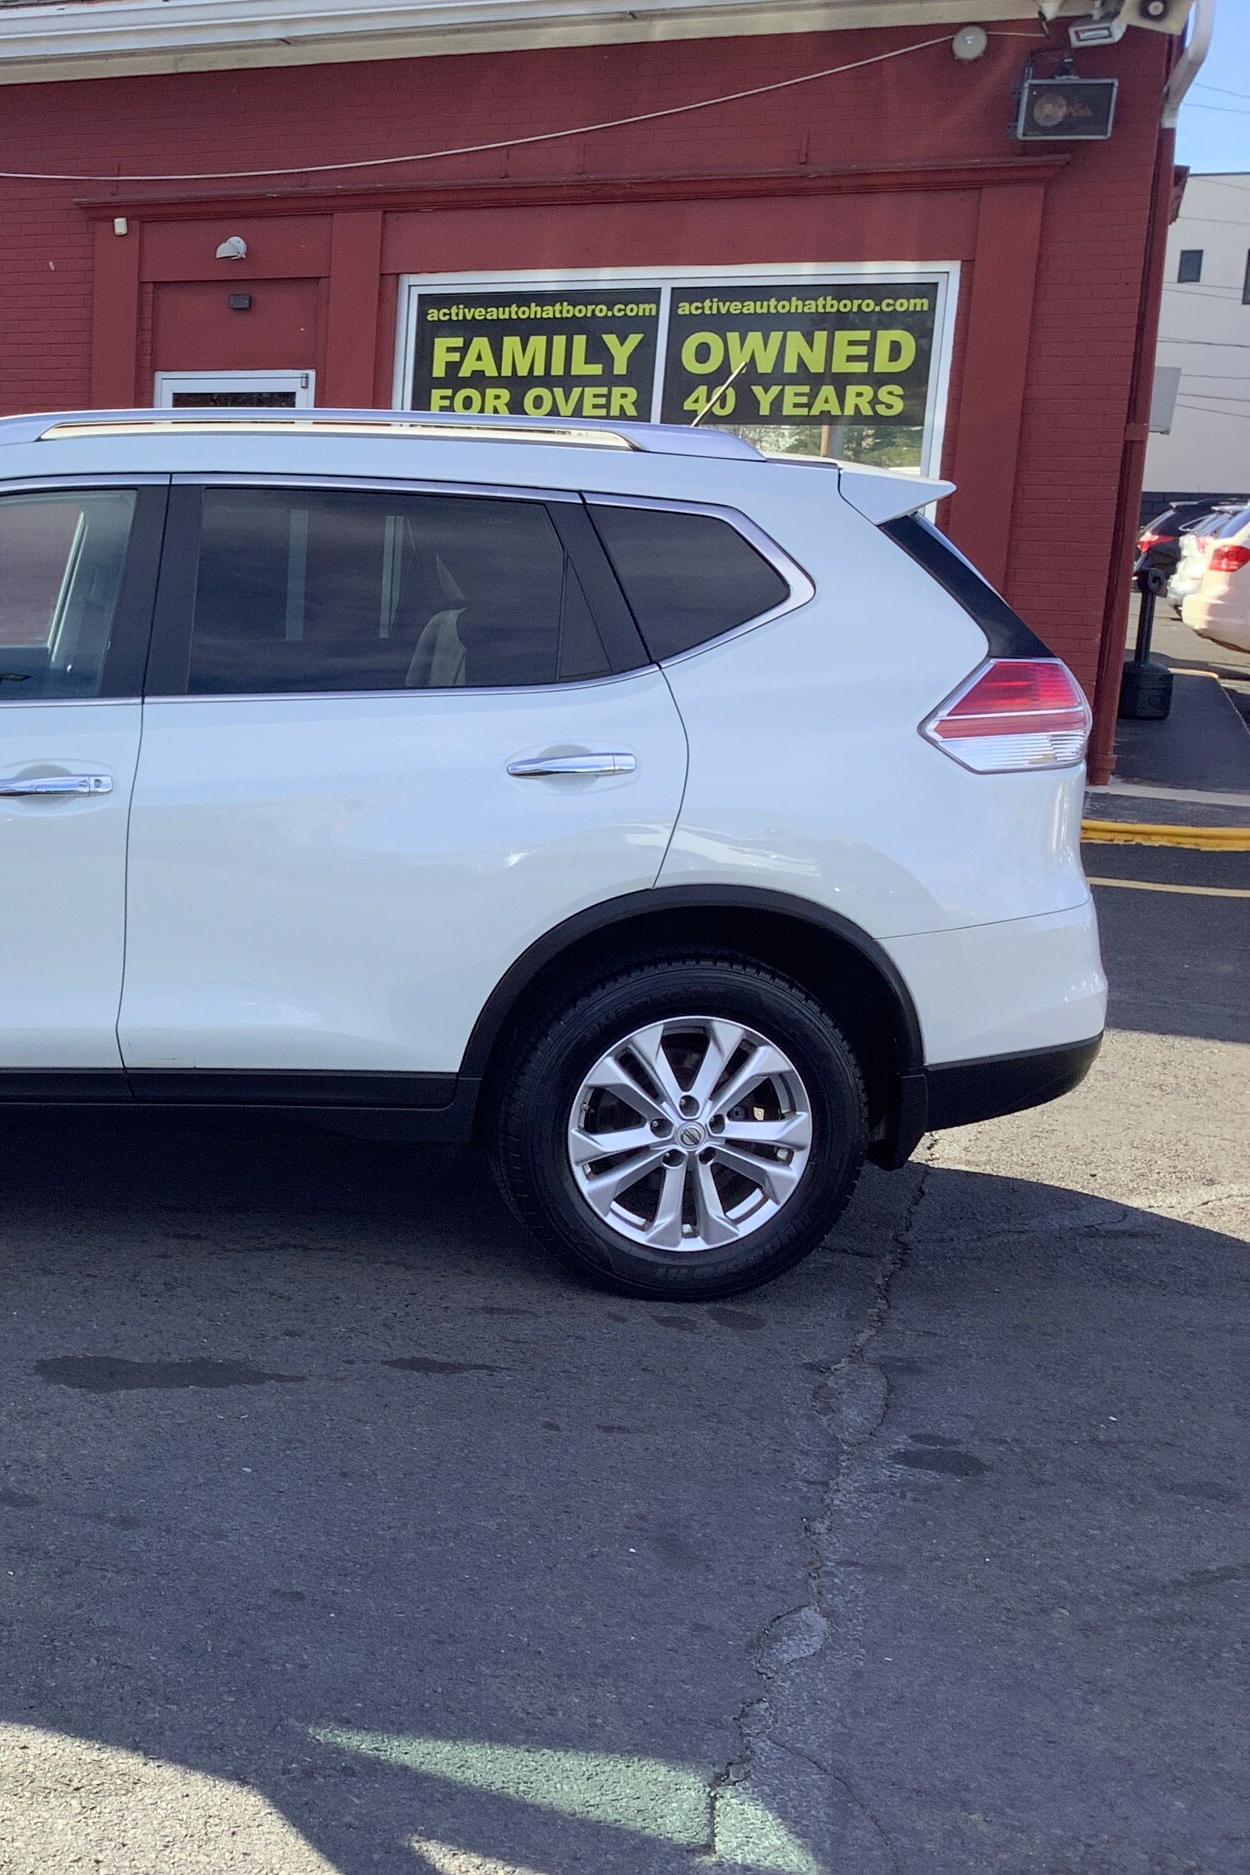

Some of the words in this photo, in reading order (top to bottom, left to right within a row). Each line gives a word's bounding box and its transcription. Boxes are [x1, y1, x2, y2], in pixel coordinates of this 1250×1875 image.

[426, 302, 657, 321] activeautohatboro.com
[677, 296, 929, 315] activeautohatboro.com
[432, 333, 645, 378] FAMILY
[681, 329, 917, 374] OWNED
[430, 387, 511, 415] FOR
[523, 386, 638, 417] OVER
[683, 385, 736, 417] 40
[751, 384, 905, 417] YEARS
